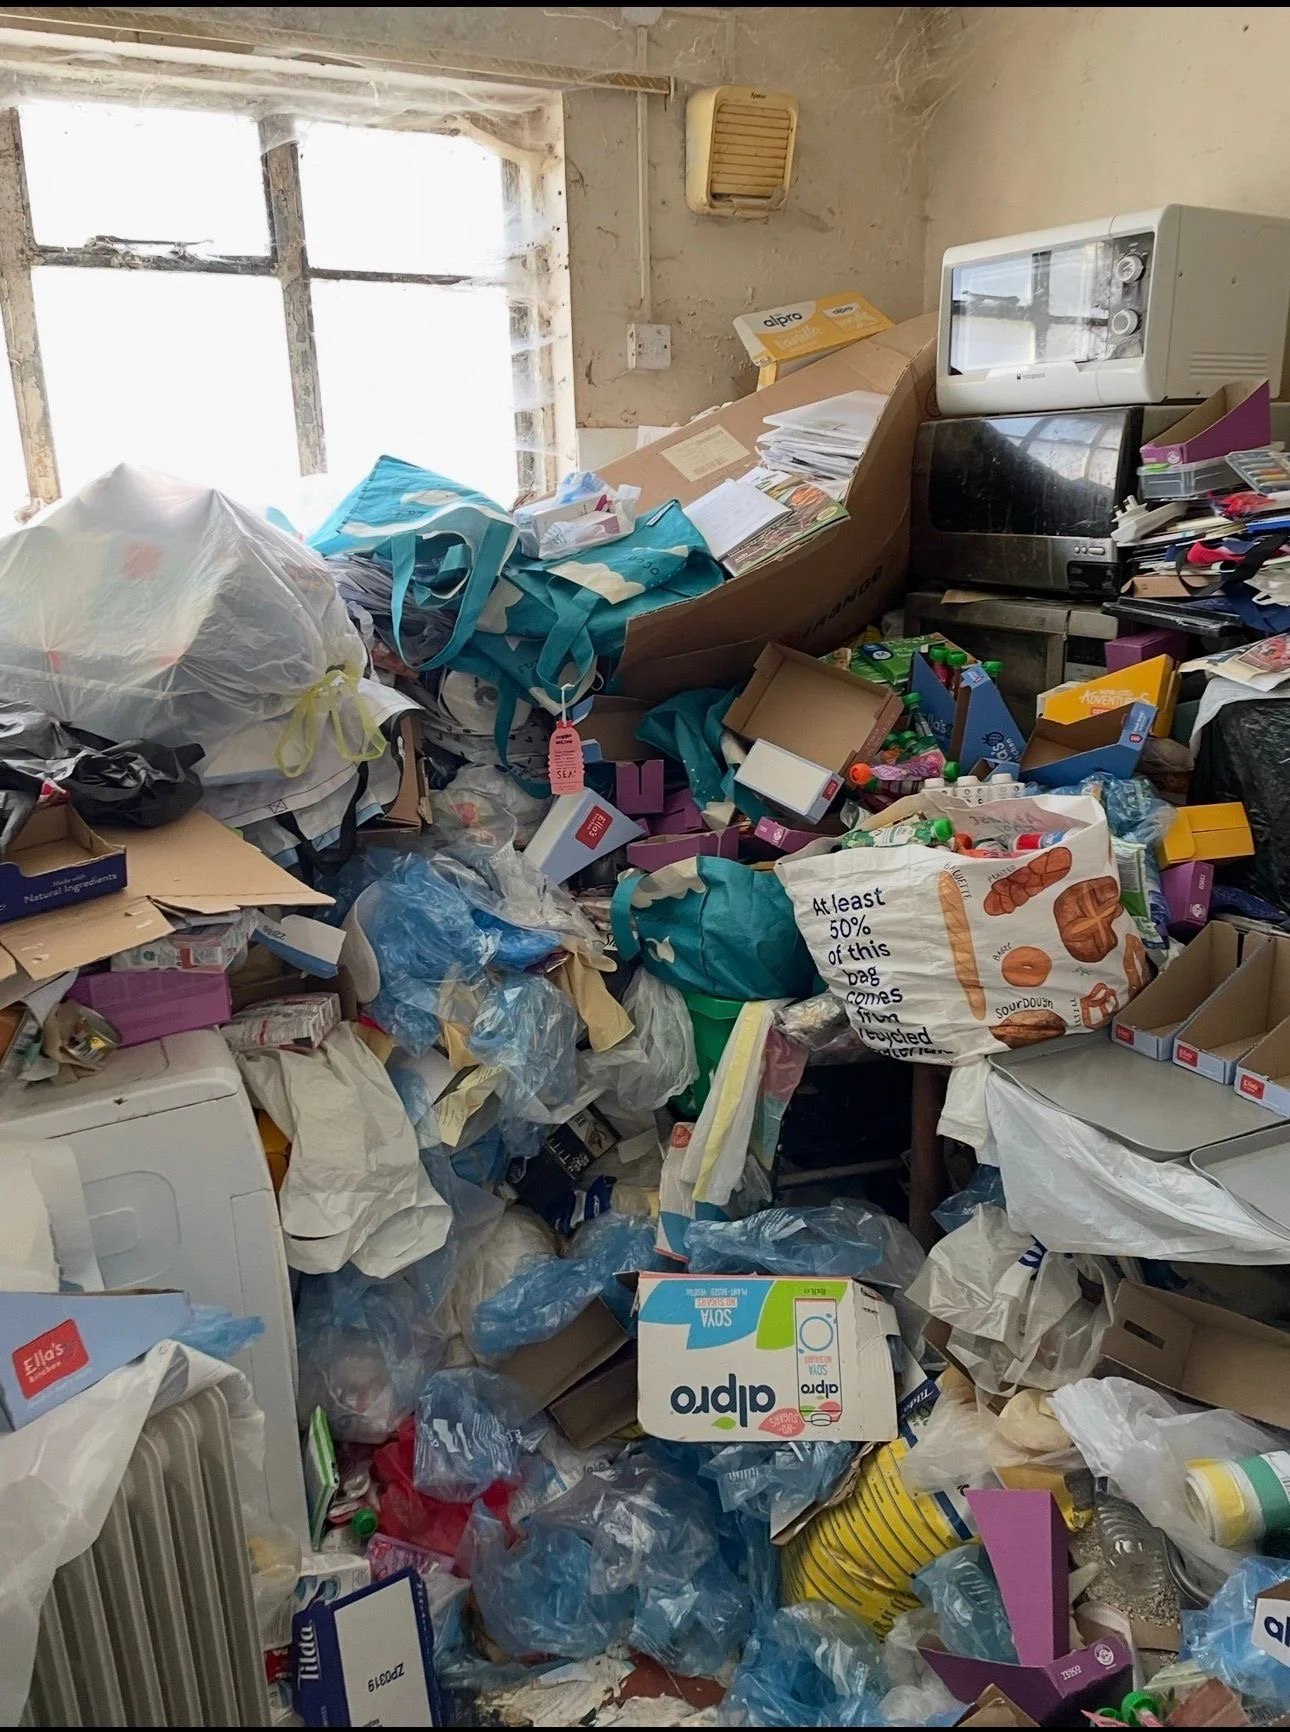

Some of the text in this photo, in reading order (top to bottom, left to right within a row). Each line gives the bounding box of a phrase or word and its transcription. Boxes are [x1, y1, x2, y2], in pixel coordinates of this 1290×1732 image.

[763, 312, 803, 328] alpro
[588, 814, 607, 837] Ella's
[24, 873, 118, 904] Natural Ingredients
[813, 888, 886, 916] At least
[830, 915, 871, 939] 50%
[828, 940, 891, 966] of this
[842, 966, 880, 987] bag
[846, 988, 903, 1005] comes
[701, 1308, 733, 1327] SOYA
[23, 1343, 65, 1377] Ella's
[808, 1364, 828, 1376] SOYA
[670, 1373, 776, 1427] alpro
[801, 1380, 839, 1399] alpro
[769, 1412, 799, 1425] SUGARS
[299, 1626, 320, 1682] Tilda
[368, 1662, 405, 1693] ZP0319
[1061, 1665, 1081, 1678] TESCO
